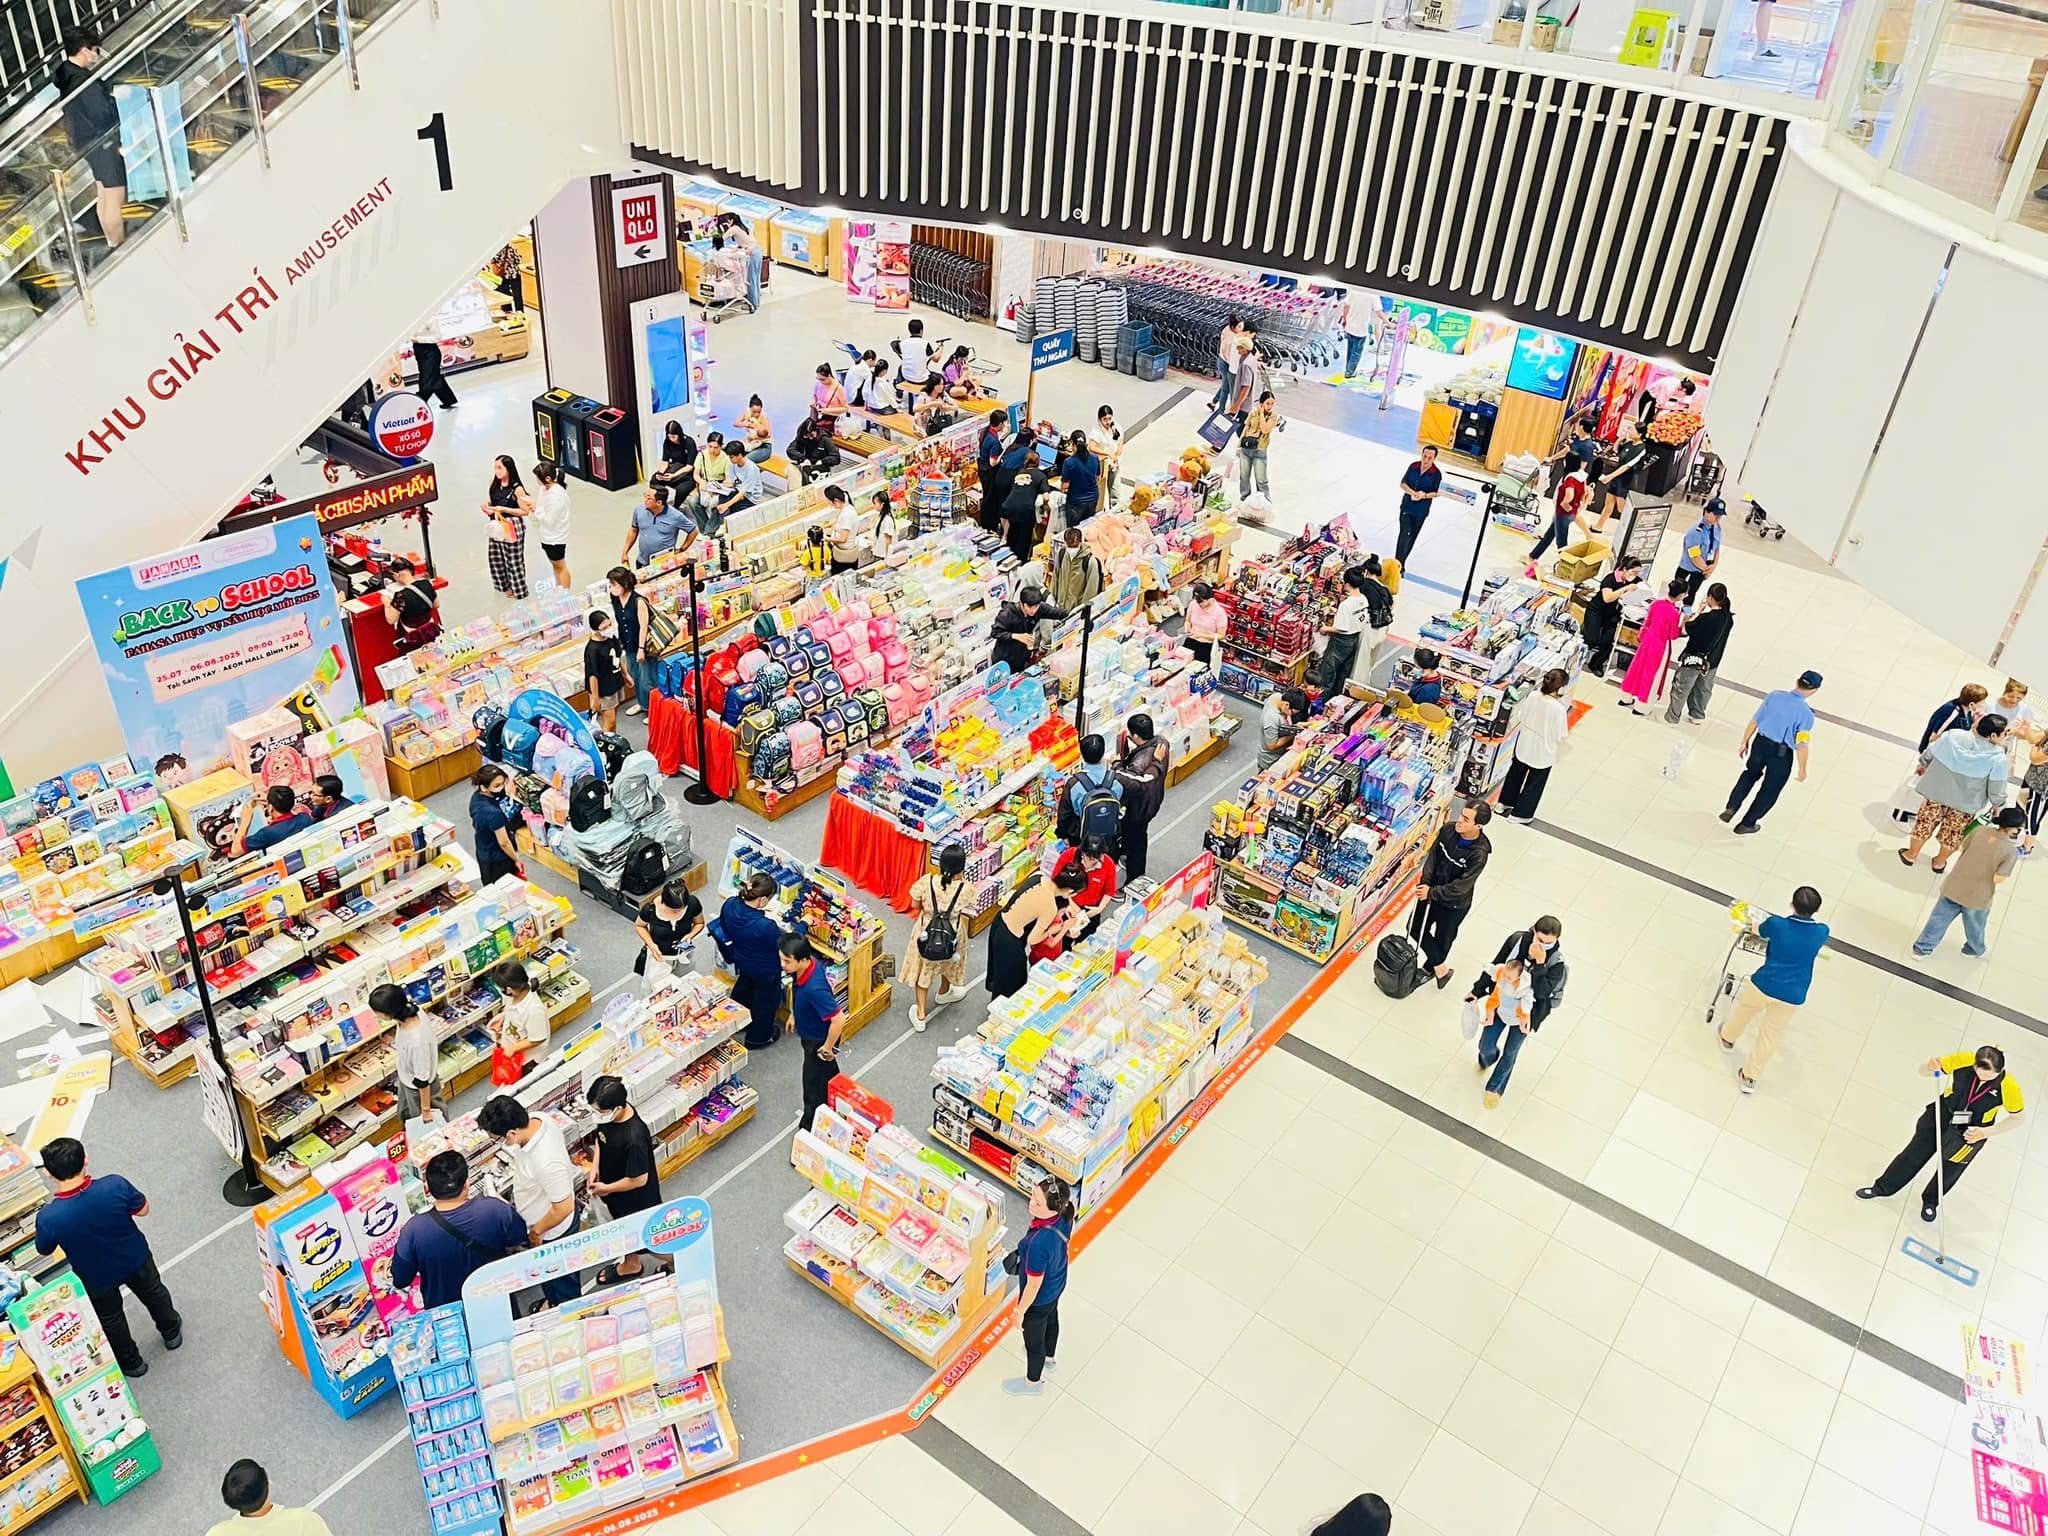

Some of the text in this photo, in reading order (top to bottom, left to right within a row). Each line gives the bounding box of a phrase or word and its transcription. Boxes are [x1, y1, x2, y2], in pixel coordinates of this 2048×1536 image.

[416, 112, 453, 191] 1
[626, 200, 651, 219] UNI
[285, 177, 392, 286] AMUSEMENT
[627, 218, 654, 239] QLO
[65, 266, 279, 475] KHU GIẢI TRÍ
[382, 416, 415, 429] Vietlott
[139, 554, 200, 581] FAHASA
[121, 600, 192, 638] BACK
[193, 597, 220, 617] TO
[220, 564, 316, 610] SCHOOL
[125, 636, 174, 659] FAHASA
[294, 590, 320, 605] 2025
[248, 640, 273, 653] 09:00
[281, 630, 304, 643] 22:00
[156, 670, 182, 684] 25.07
[190, 651, 241, 672] 06.08.2025
[223, 661, 243, 672] AEON
[245, 654, 264, 665] MALL
[553, 1222, 625, 1254] MegaBook
[312, 1261, 352, 1294] RACER
